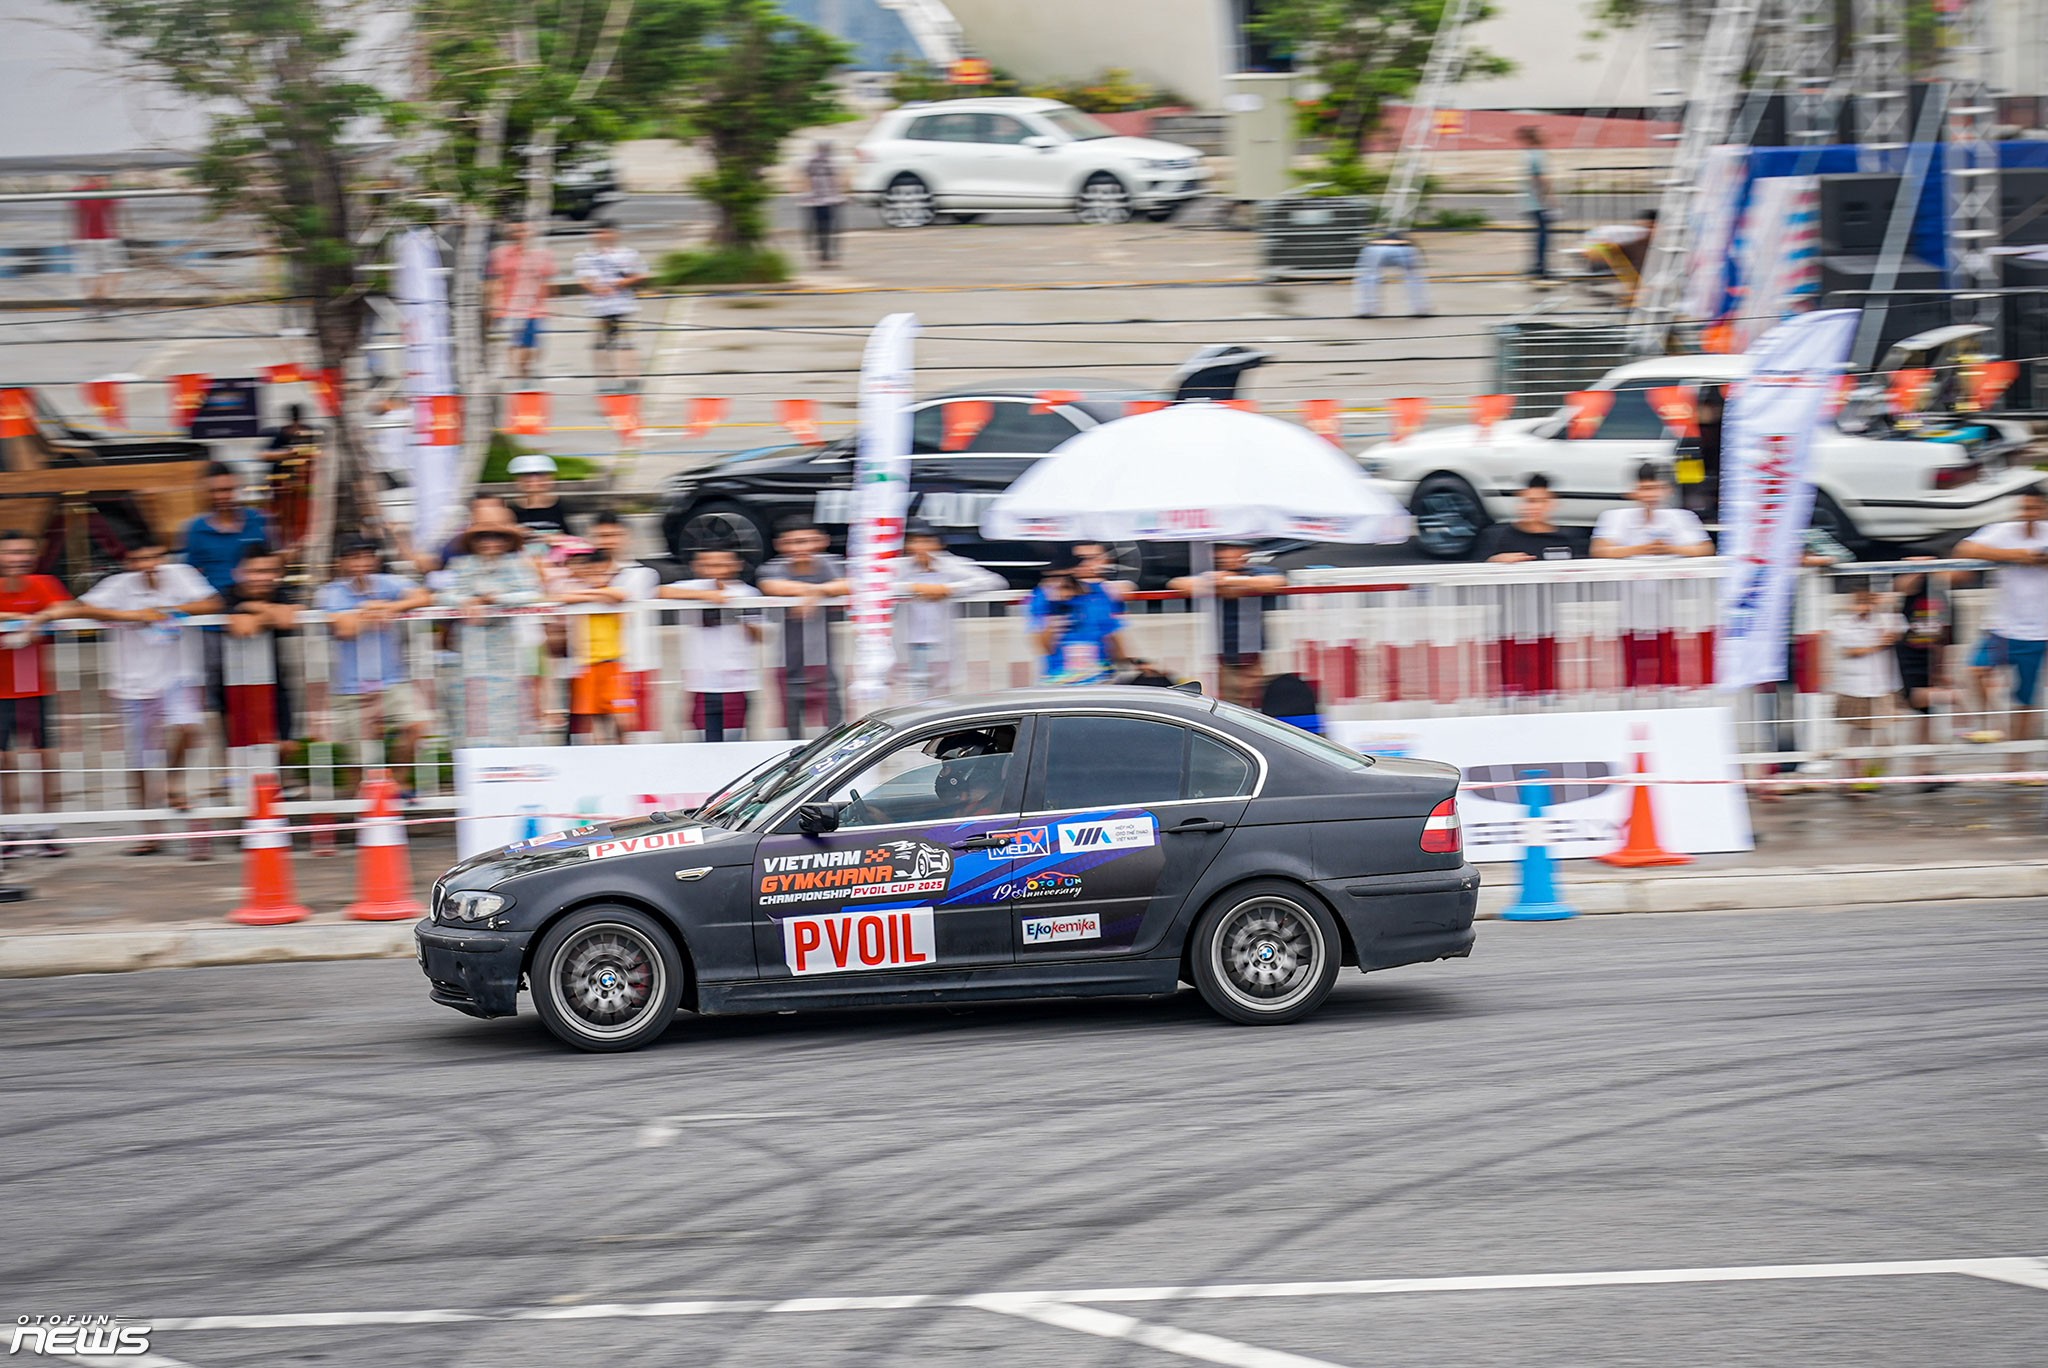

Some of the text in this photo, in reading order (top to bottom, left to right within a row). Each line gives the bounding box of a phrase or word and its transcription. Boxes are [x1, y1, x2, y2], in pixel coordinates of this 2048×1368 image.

[596, 832, 695, 857] PVOIL
[992, 830, 1045, 845] TV
[994, 843, 1047, 856] MEDIA
[763, 850, 862, 873] VIETNAM
[760, 865, 894, 893] GYMKHANA
[759, 881, 943, 905] CHAMPIONSHIP PVOIL CUP 2025
[1012, 887, 1082, 899] Anniversary
[1026, 919, 1096, 940] Ekokemika
[794, 913, 926, 971] PVOIL
